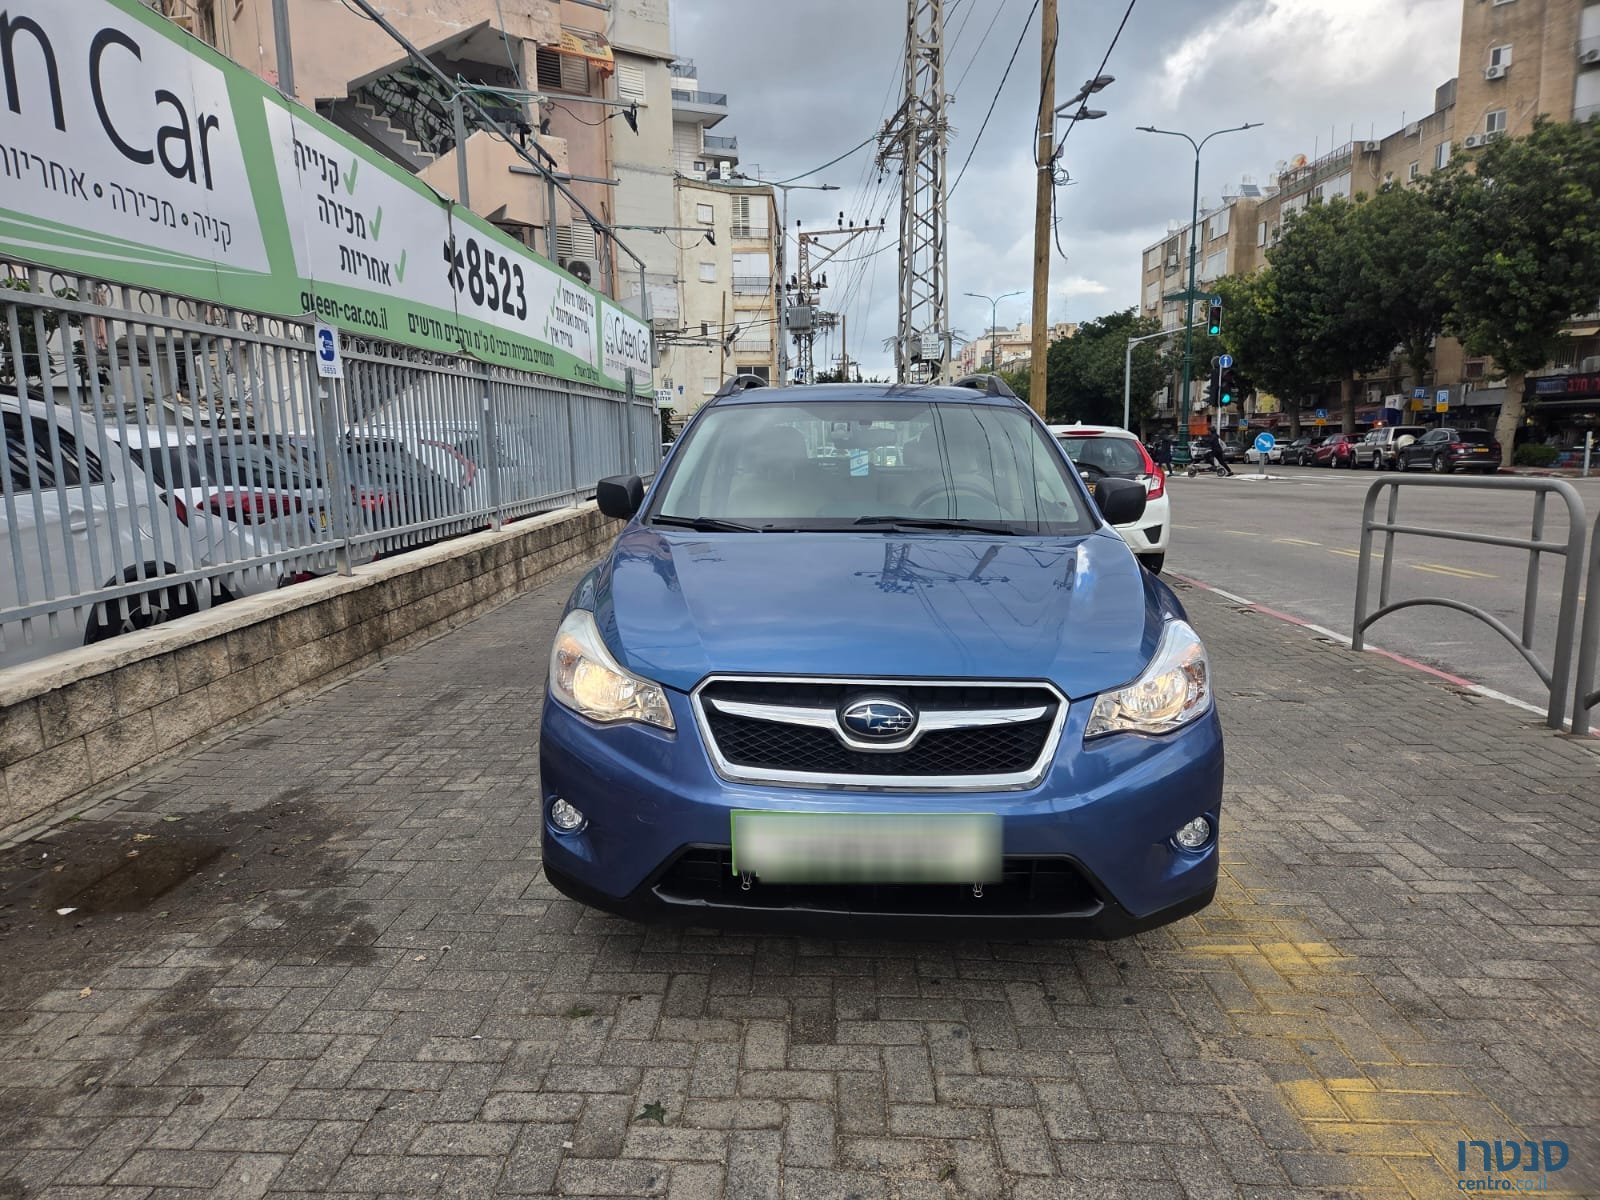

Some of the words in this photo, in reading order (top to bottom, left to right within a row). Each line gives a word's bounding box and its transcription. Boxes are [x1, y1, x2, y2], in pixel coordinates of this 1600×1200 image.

[89, 27, 219, 191] Car
[110, 182, 176, 228] מכירה
[317, 194, 367, 240] מכירה
[193, 211, 231, 252] קניה
[339, 244, 392, 287] אחריות
[408, 312, 443, 340] חדשים
[496, 339, 511, 357] רכבי
